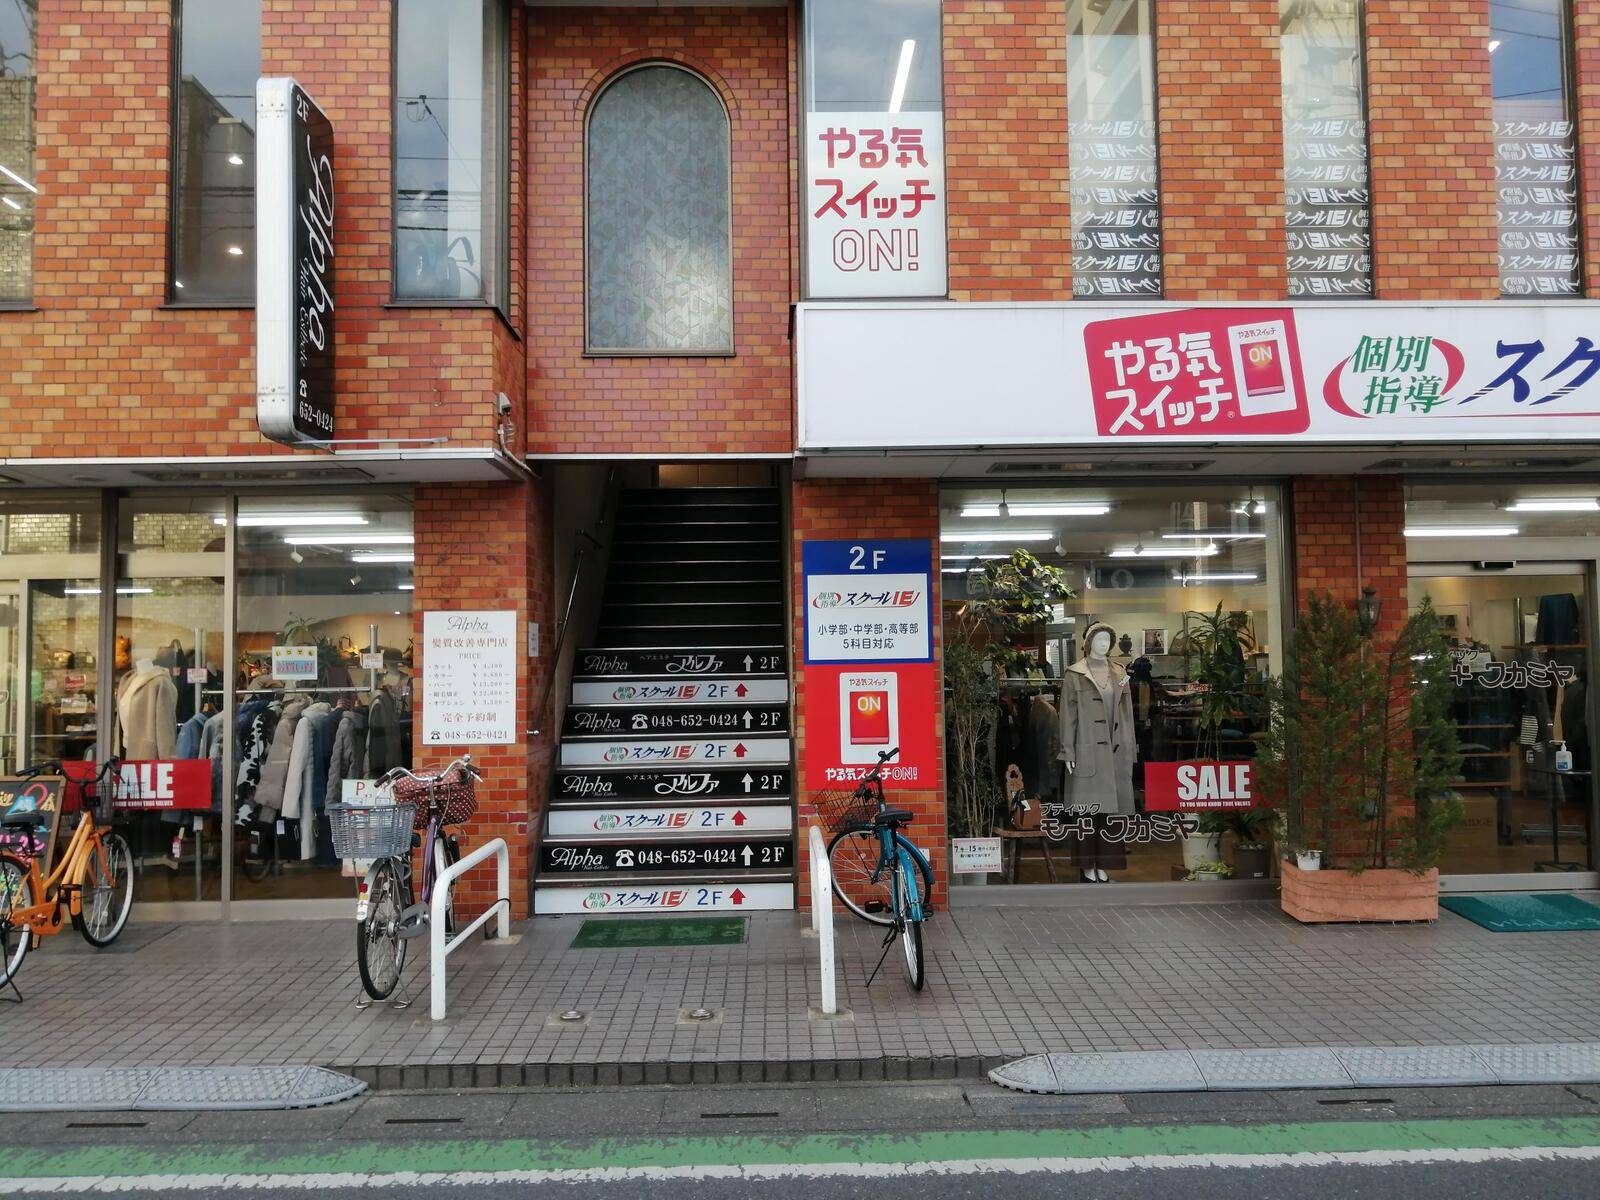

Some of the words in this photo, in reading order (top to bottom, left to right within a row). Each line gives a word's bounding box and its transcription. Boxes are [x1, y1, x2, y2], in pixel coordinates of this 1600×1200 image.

[296, 94, 309, 122] 2F
[818, 127, 928, 168] やる気
[814, 179, 936, 219] スイッチ
[299, 135, 335, 352] Alpha
[833, 228, 919, 272] ON!
[1238, 327, 1276, 339] やる気スイッチ
[1105, 331, 1222, 386] やる気
[1249, 346, 1272, 363] ON
[1353, 335, 1433, 374] 個別
[1104, 375, 1233, 436] スイッチ
[1363, 375, 1444, 415] 指導
[299, 401, 333, 433] 652-0424
[849, 546, 886, 570] 2F
[840, 590, 915, 607] スクールIE
[447, 616, 489, 633] Alpha
[818, 623, 919, 636] 小学部・中学部・高等部
[843, 637, 895, 649] 5科目対応
[584, 655, 629, 676] Alpha
[760, 656, 780, 669] 2F
[1478, 660, 1575, 689] ワカミヤ
[638, 685, 696, 699] スクールIE
[708, 684, 729, 698] 2F
[849, 678, 888, 686] やる気スイッチ
[857, 696, 881, 712] ON
[574, 712, 621, 734] Alpha
[652, 715, 738, 728] 048-652-0424
[760, 712, 781, 726] 2F
[444, 731, 508, 740] 048-652-0424
[632, 745, 691, 759] スクールIE
[705, 744, 727, 758] 2F
[113, 763, 174, 799] ALE
[563, 775, 612, 797] Alpha
[761, 775, 782, 789] 2F
[1177, 765, 1251, 800] SALE
[622, 813, 687, 828] スクールIE
[701, 811, 725, 827] 2F
[1040, 803, 1101, 816] ブティック
[1040, 818, 1095, 841] モード
[1101, 813, 1201, 843] ワカミヤ
[551, 847, 603, 871] Alpha
[638, 849, 736, 865] 048-652-0424
[761, 847, 785, 863] 2F
[613, 890, 681, 906] スクールIE
[697, 889, 722, 905] 2F
